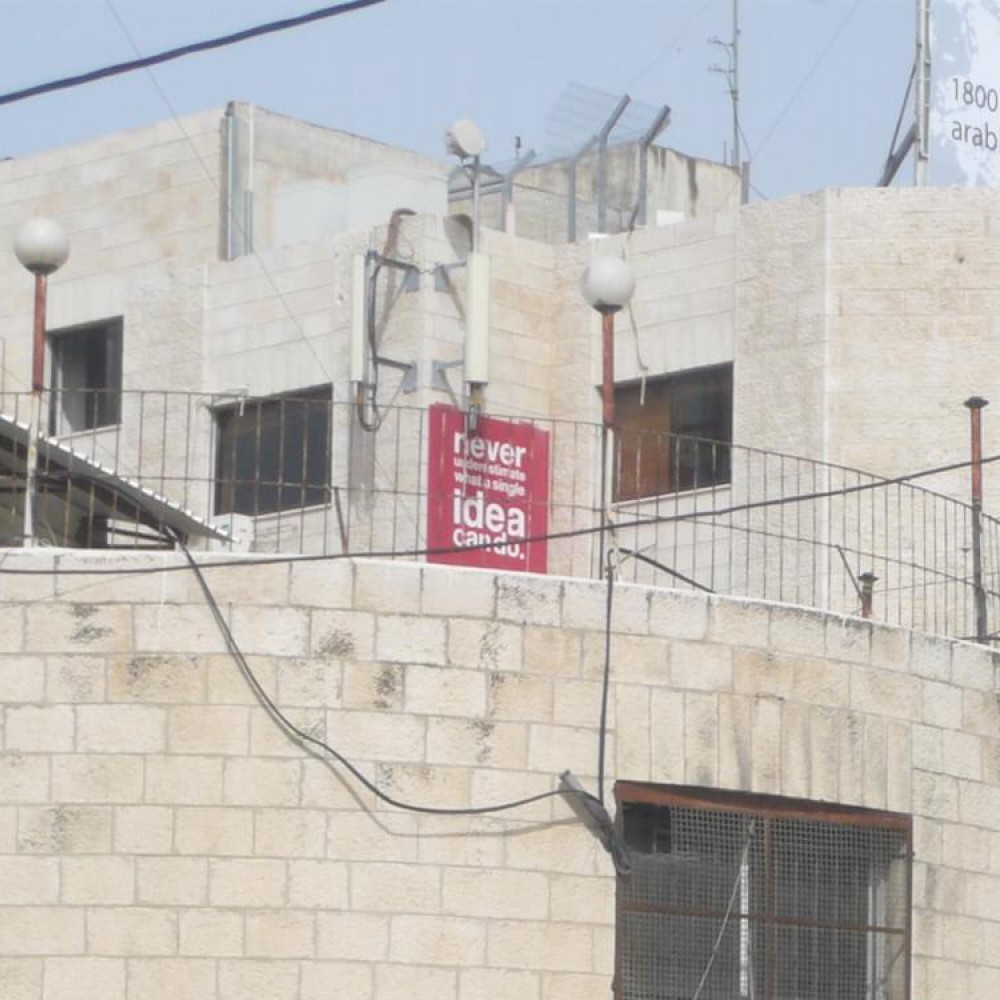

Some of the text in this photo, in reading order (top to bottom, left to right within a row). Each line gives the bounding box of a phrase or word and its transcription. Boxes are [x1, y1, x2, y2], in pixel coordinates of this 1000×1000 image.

[952, 77, 998, 113] 1800
[453, 431, 527, 468] never
[453, 488, 527, 538] idea
